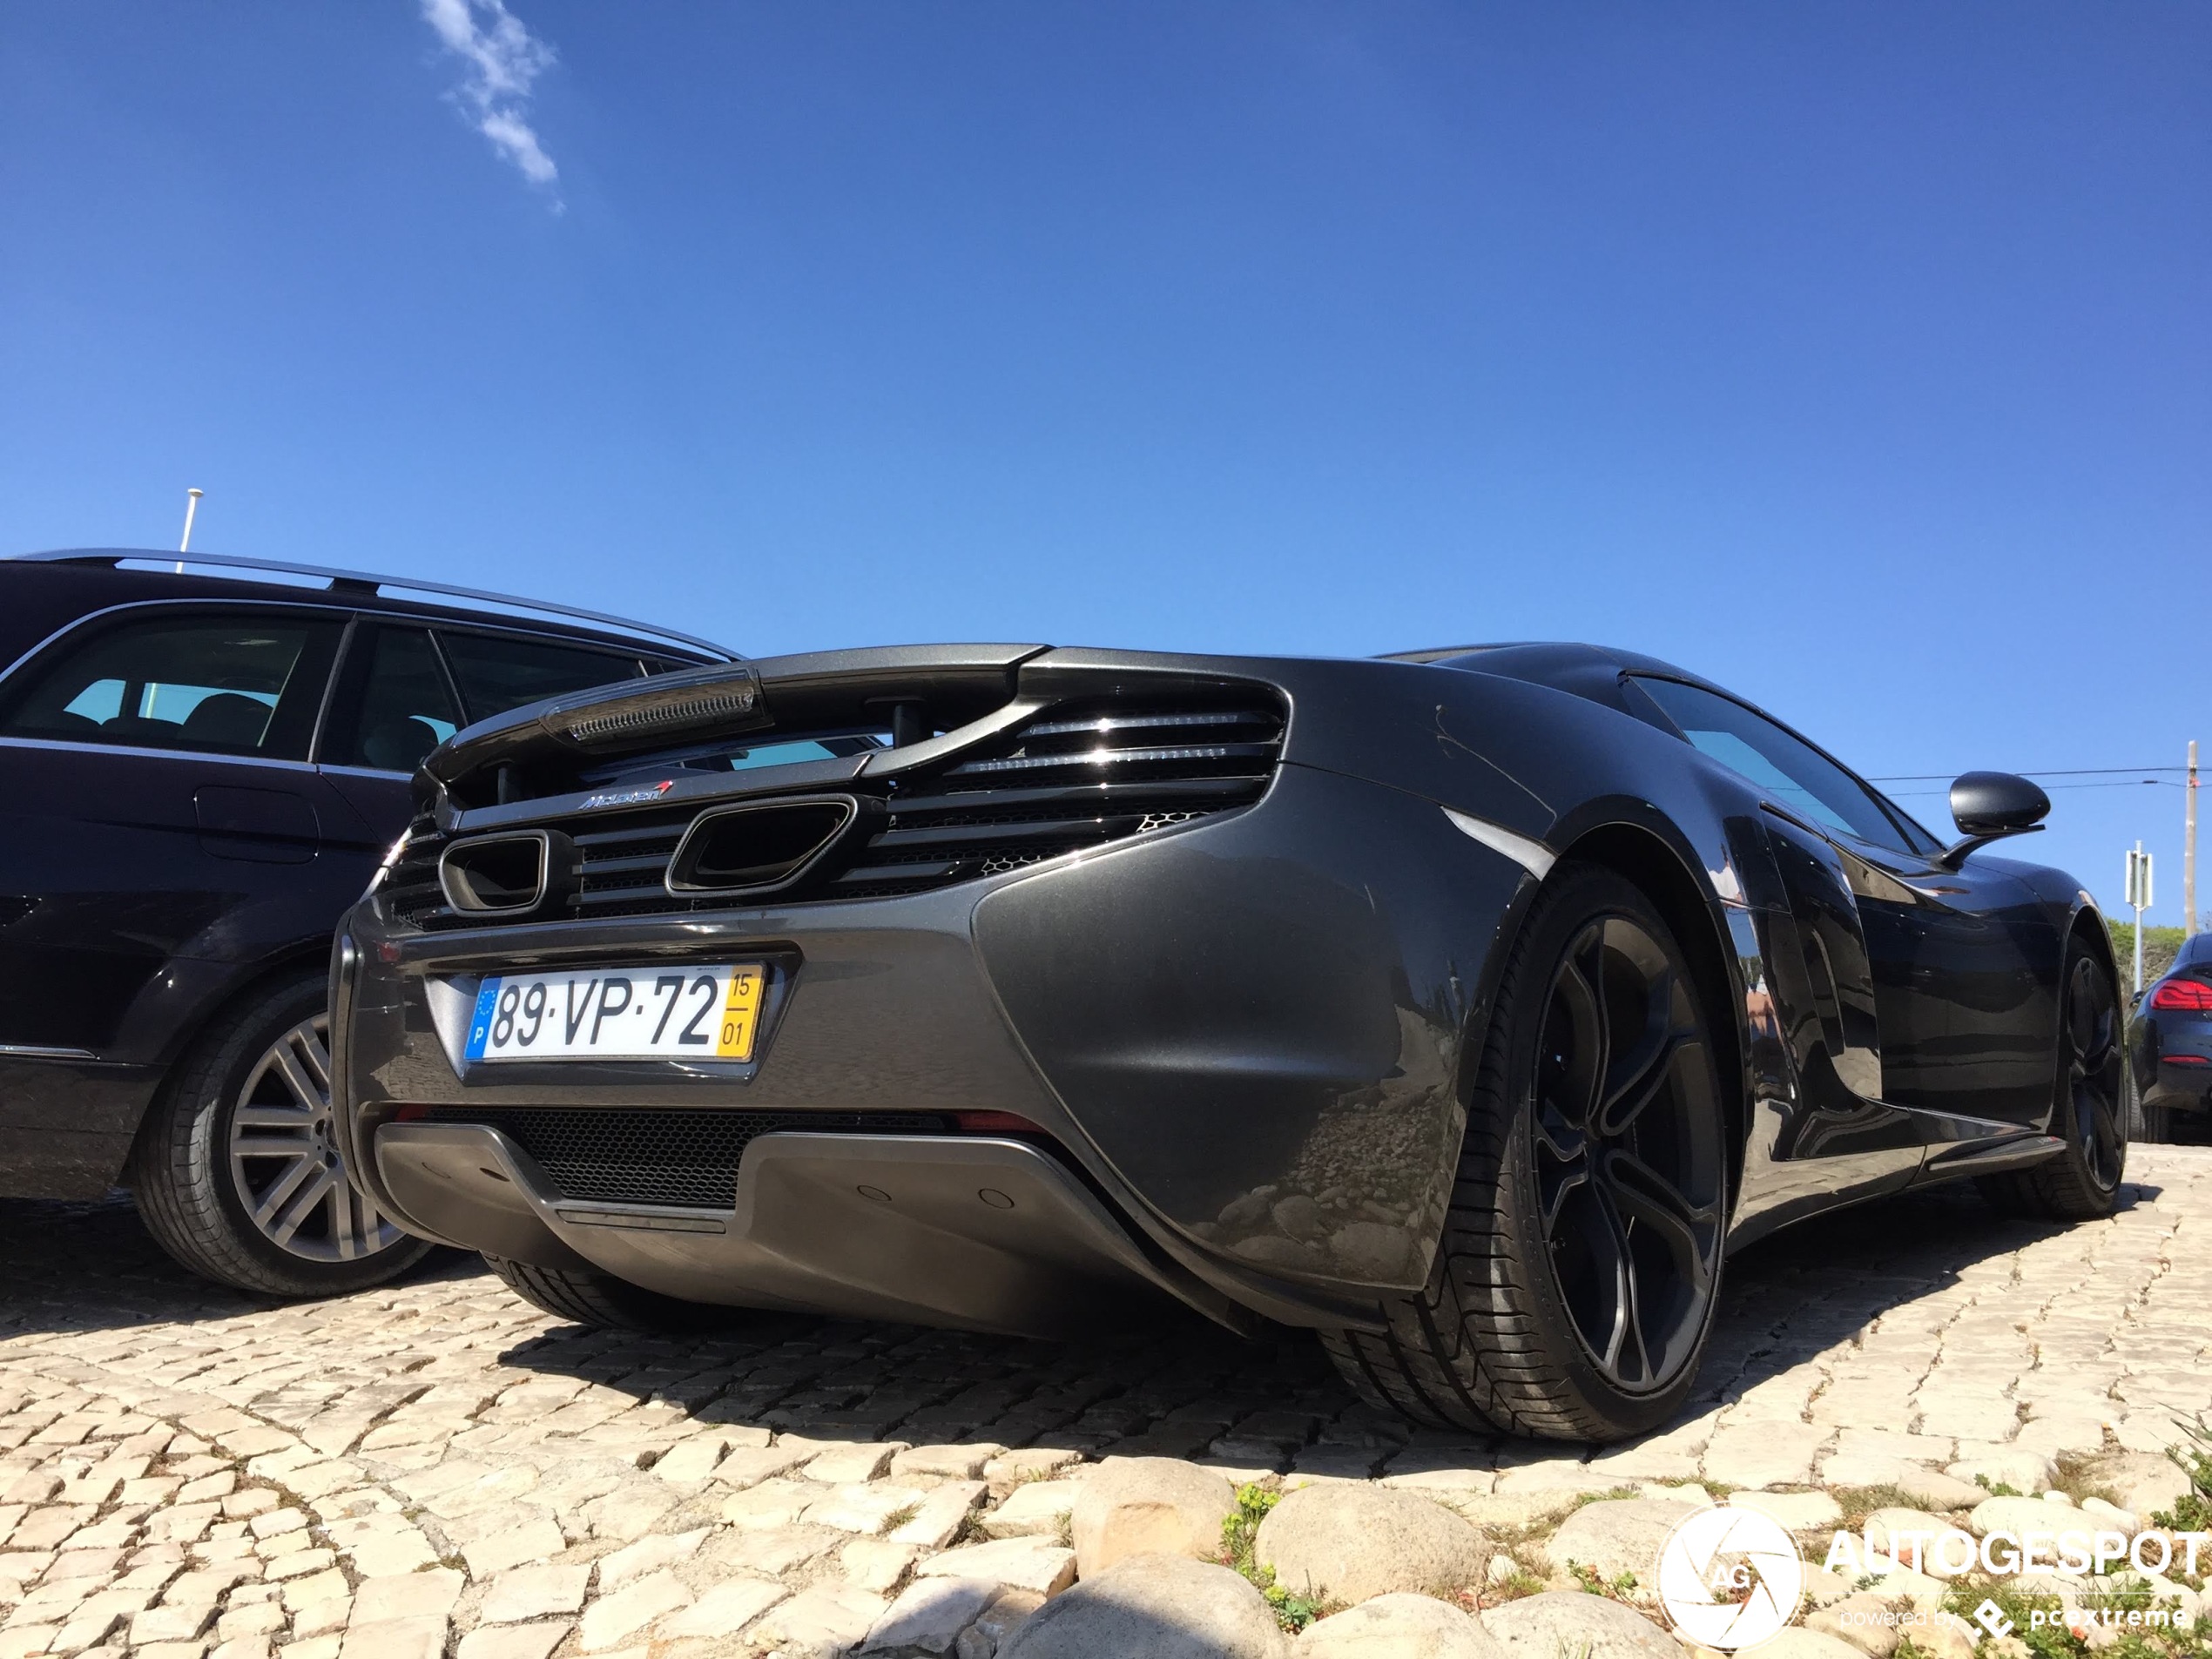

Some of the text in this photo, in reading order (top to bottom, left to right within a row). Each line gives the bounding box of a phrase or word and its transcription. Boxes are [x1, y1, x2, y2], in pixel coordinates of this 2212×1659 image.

[733, 973, 752, 997] 15
[473, 1026, 484, 1044] P
[722, 1022, 744, 1045] 01
